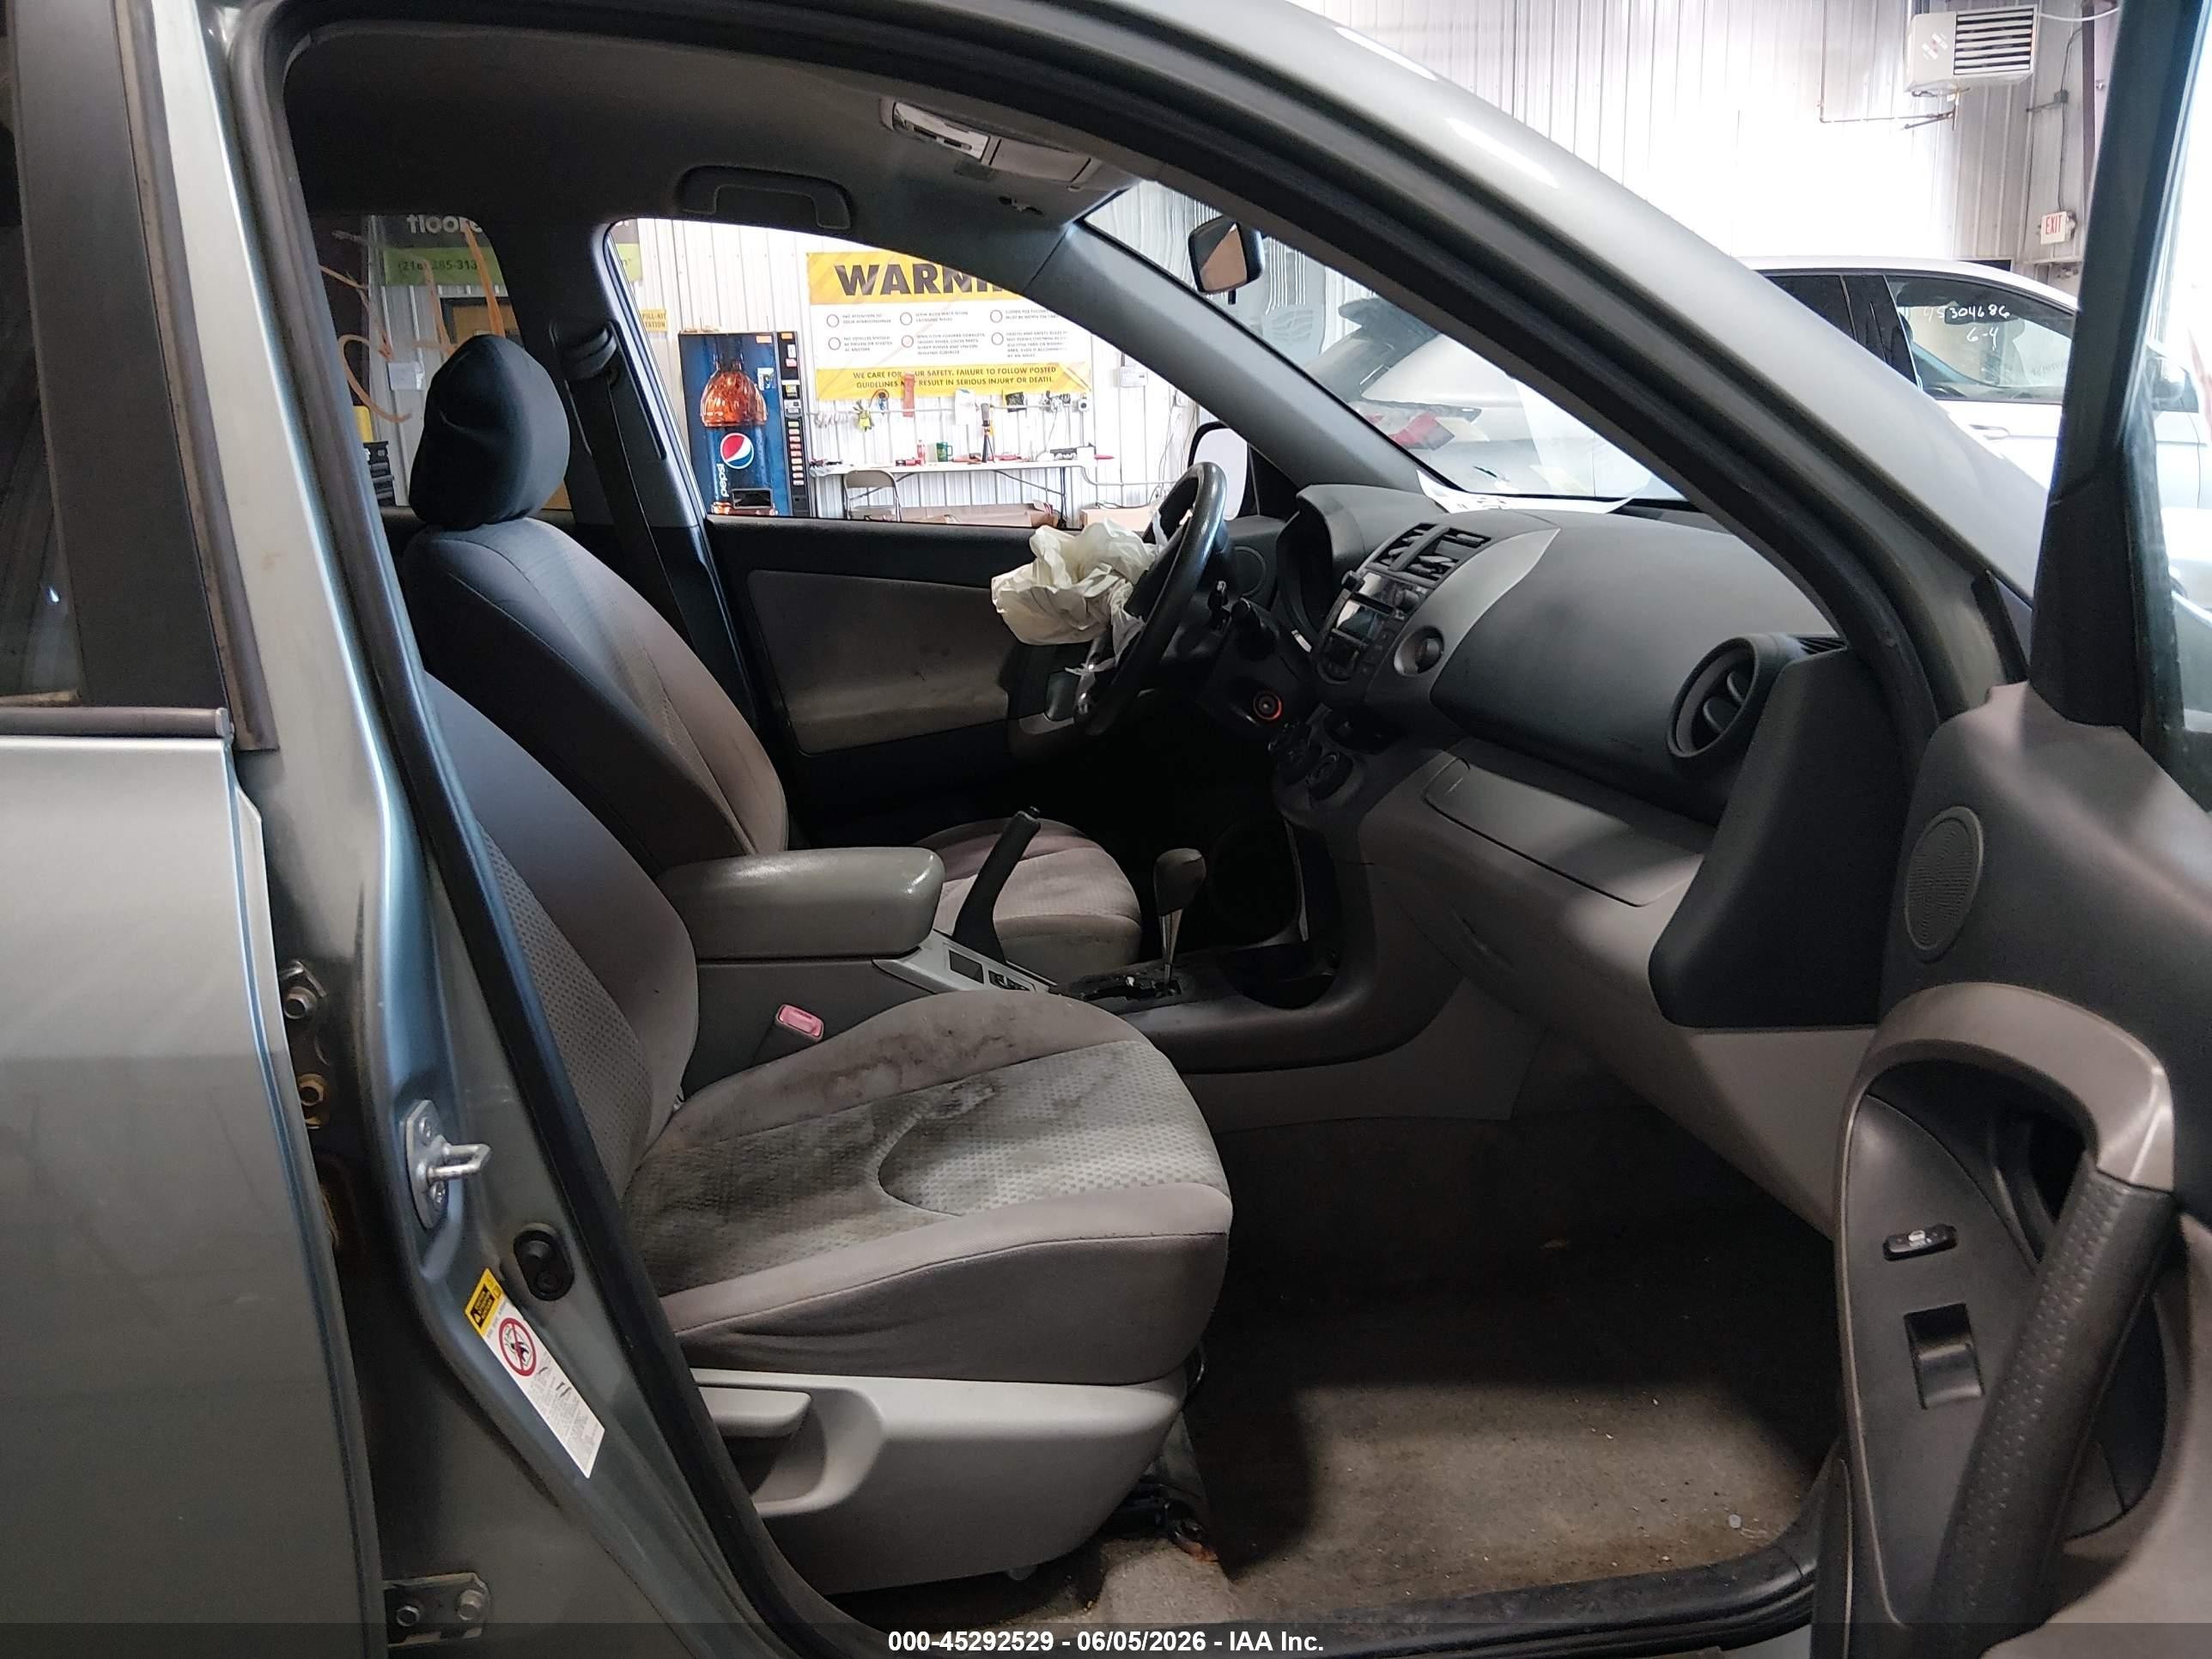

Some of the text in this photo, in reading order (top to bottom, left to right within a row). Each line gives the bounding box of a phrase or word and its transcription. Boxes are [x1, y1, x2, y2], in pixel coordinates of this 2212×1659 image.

[2045, 215, 2063, 234] EXIT
[835, 263, 1003, 295] WARN
[856, 380, 898, 389] GUIDELINES
[716, 464, 729, 497] pepsi
